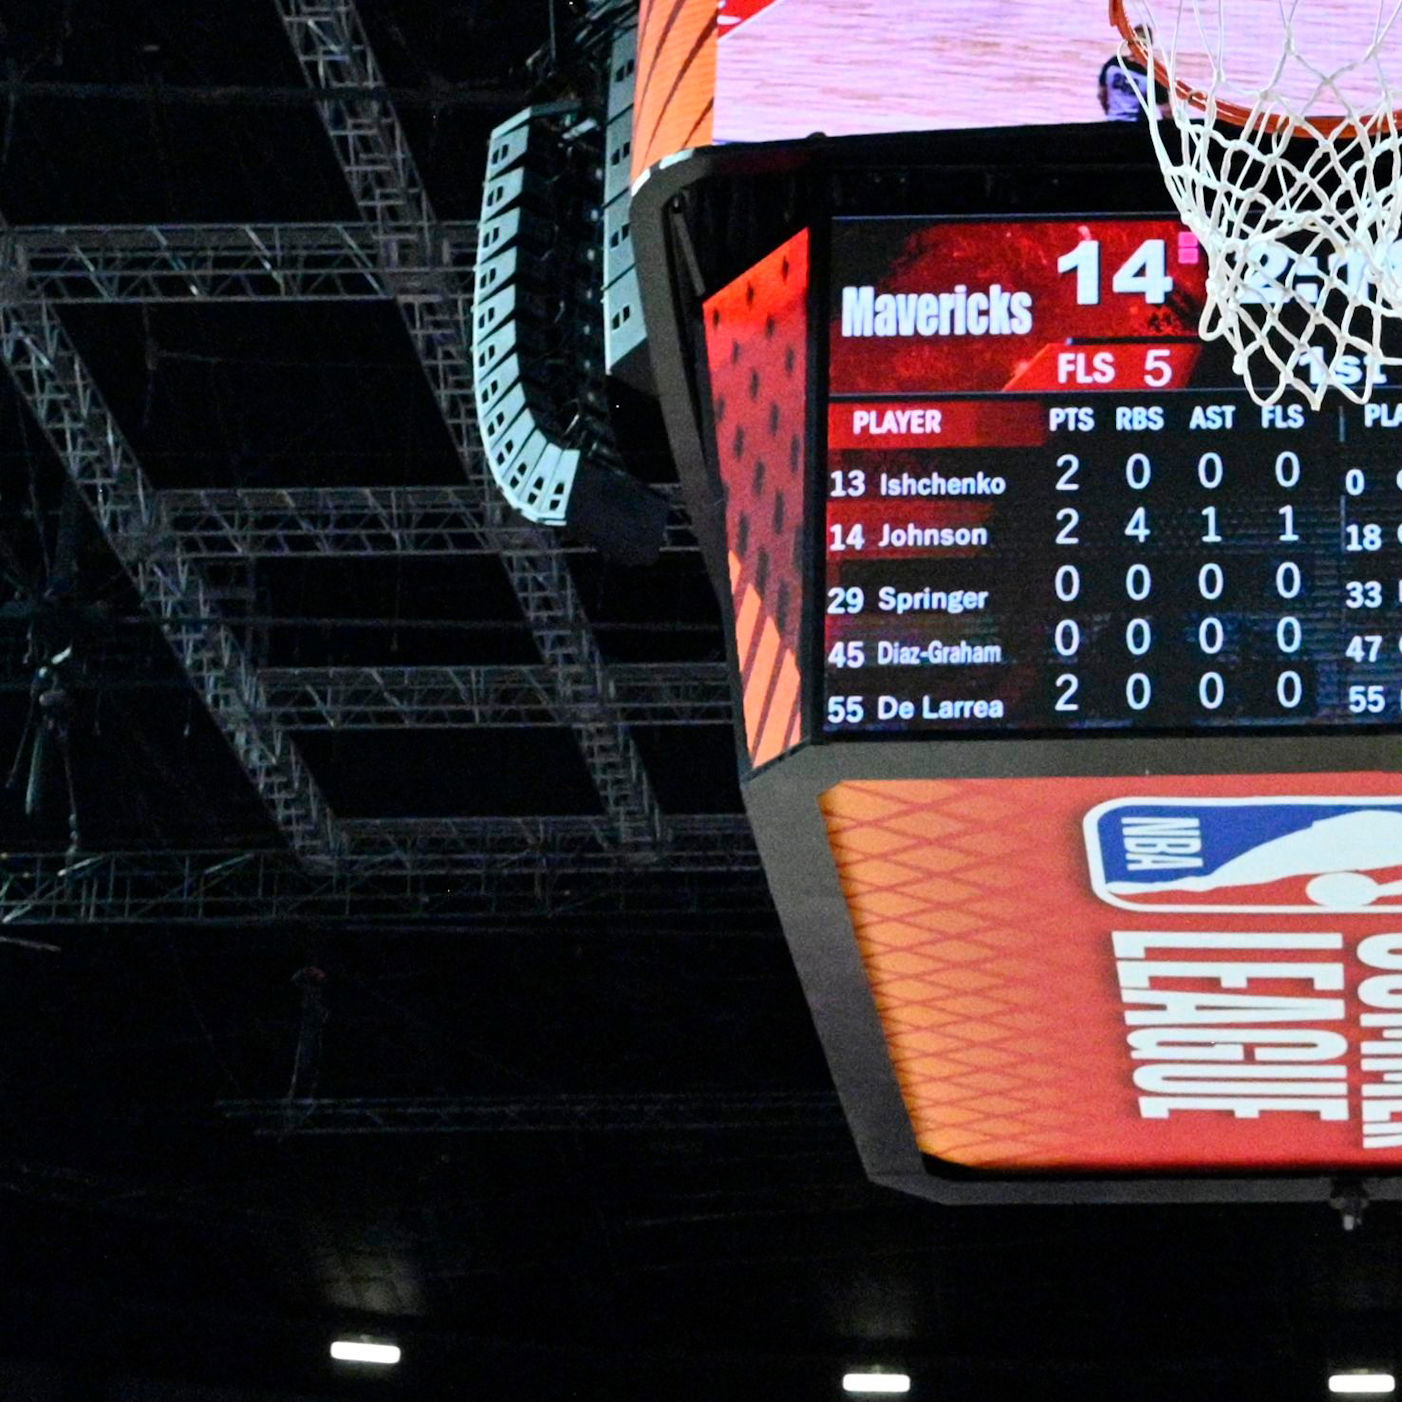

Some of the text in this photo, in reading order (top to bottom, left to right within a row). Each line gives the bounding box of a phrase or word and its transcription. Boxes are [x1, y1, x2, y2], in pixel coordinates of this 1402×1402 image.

[1058, 238, 1173, 306] 14
[842, 285, 1032, 338] Mavericks
[1058, 349, 1173, 387] FLS 5
[853, 405, 1304, 434] PLAYER PTS RBS AST FLS
[830, 452, 1300, 497] 13 Ishchenko 2 0 0 0
[1346, 469, 1364, 495] 0
[830, 505, 1298, 551] 14 Johnson 2 4 1 1
[1346, 524, 1381, 551] 18
[827, 562, 1300, 615] 29 Springer 0 0 0 0
[1346, 581, 1382, 608] 33
[828, 616, 1301, 668] 45 Diaz-Graham 0 0 0 0
[1346, 635, 1382, 662] 47
[828, 671, 1301, 723] 55 De Larrea 2 0 0 0
[1349, 686, 1385, 712] 55
[1121, 816, 1203, 871] NBA
[1111, 931, 1350, 1121] LEAGUE
